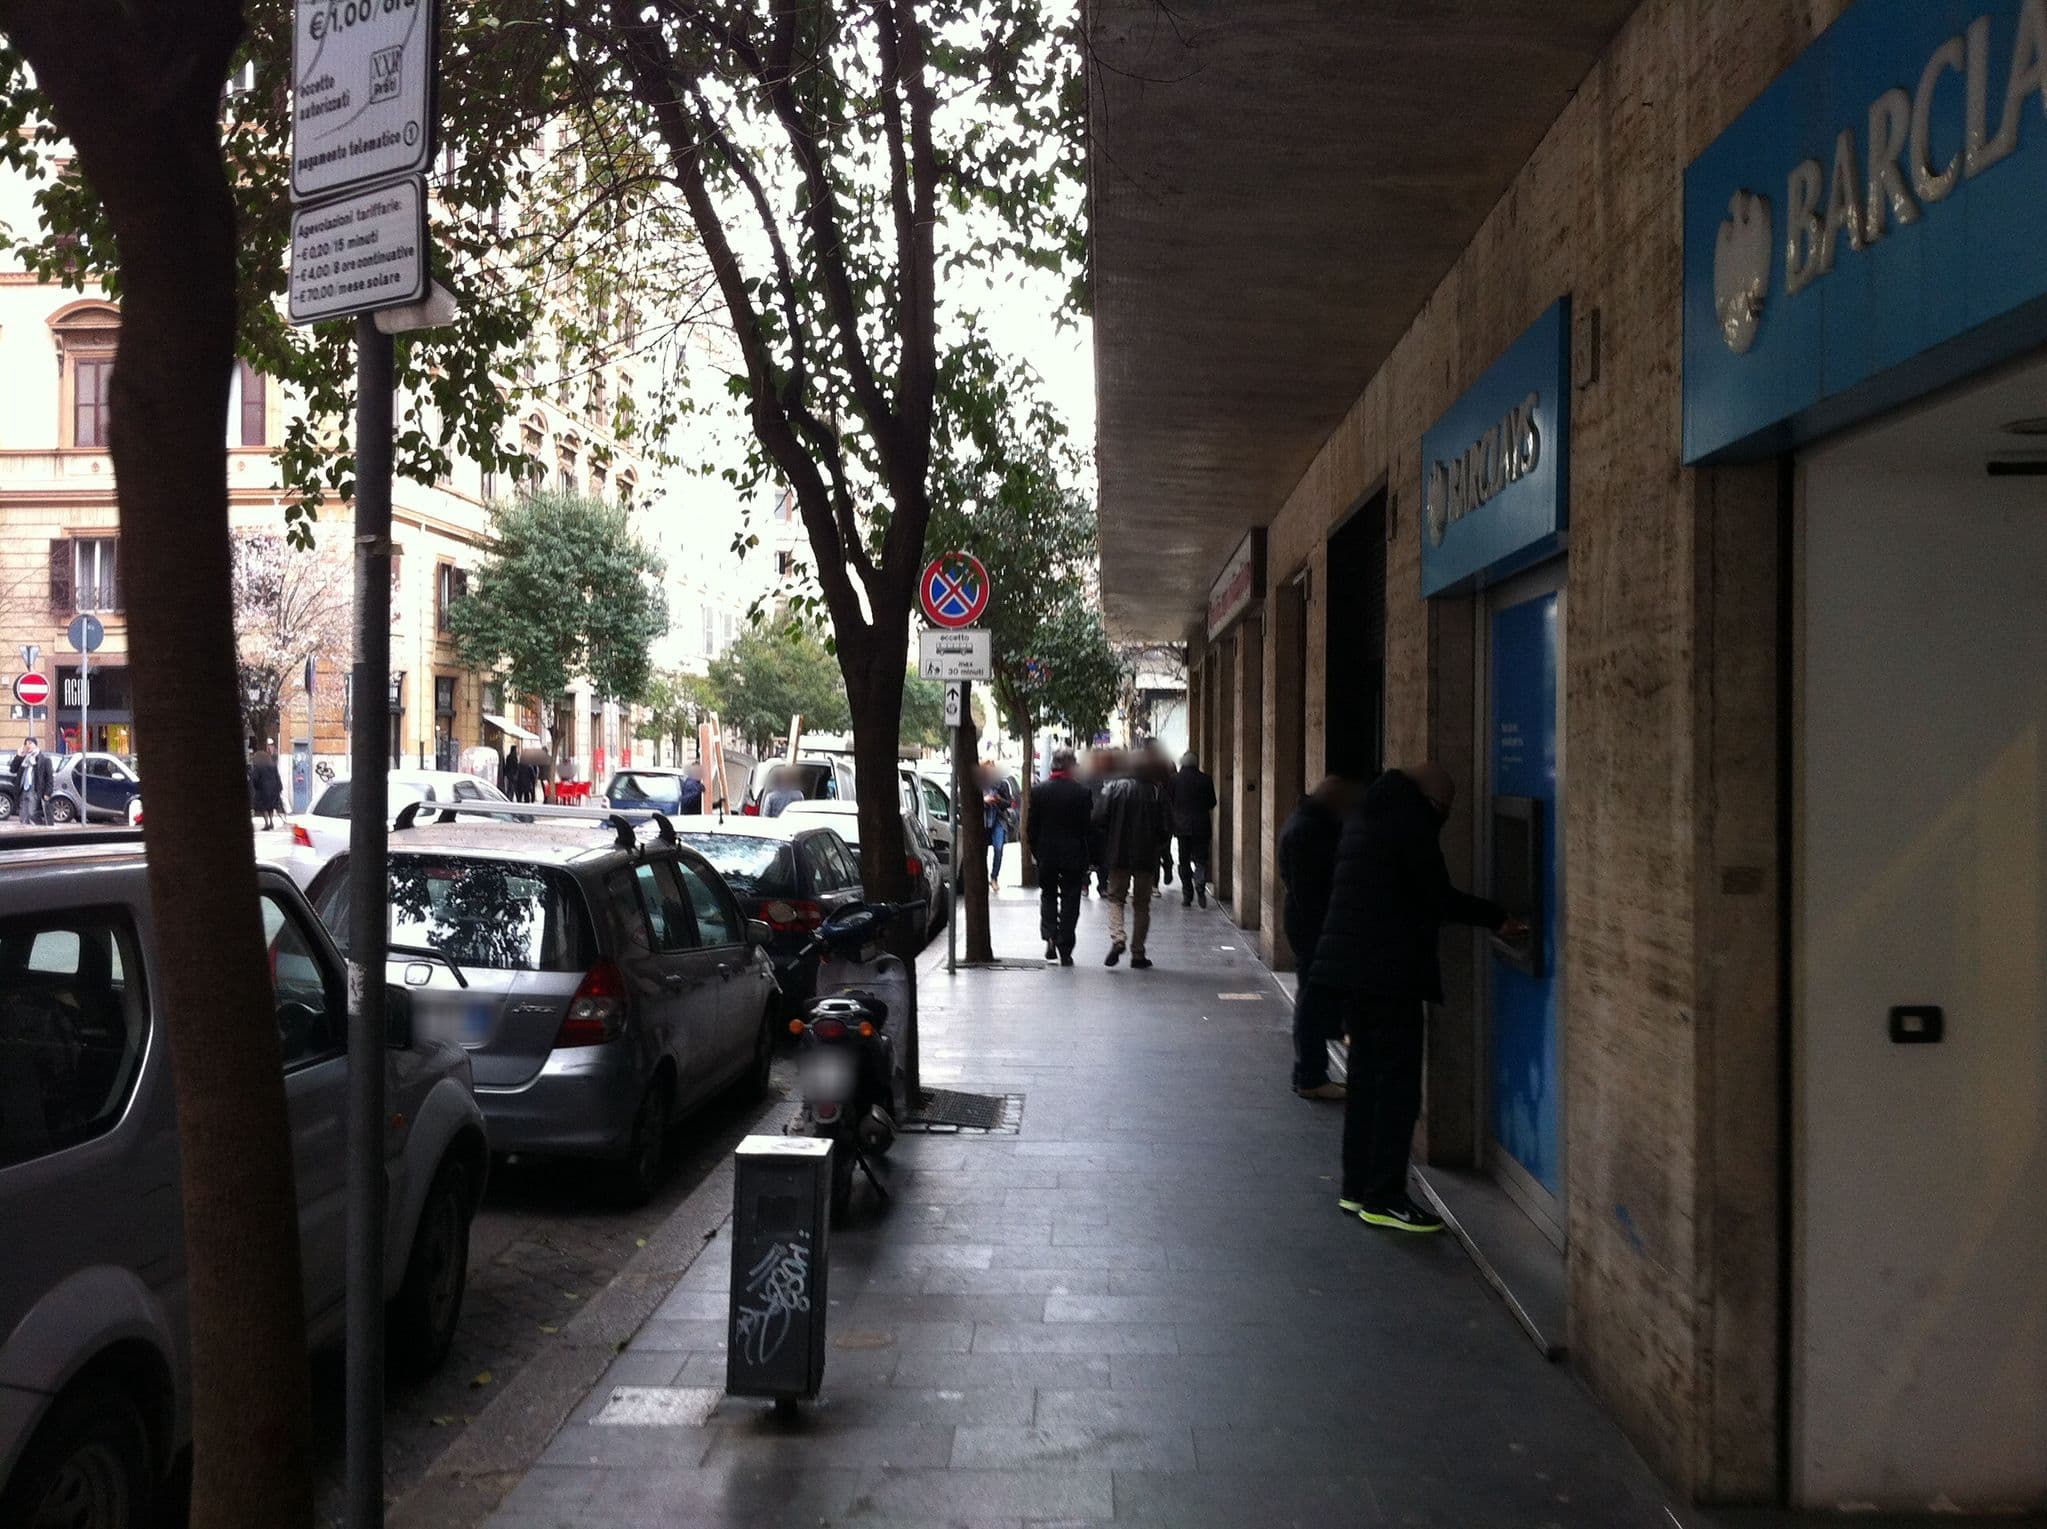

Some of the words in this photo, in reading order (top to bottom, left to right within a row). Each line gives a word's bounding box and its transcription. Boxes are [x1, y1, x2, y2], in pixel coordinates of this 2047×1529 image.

[298, 145, 346, 170] pagamento
[349, 131, 401, 156] telematico
[298, 210, 353, 239] Agevolazioni
[333, 238, 344, 252] 15
[347, 229, 379, 249] minuti
[342, 260, 355, 271] ore
[358, 245, 414, 268] continuative
[338, 279, 365, 294] mese
[368, 272, 400, 288] solare
[948, 668, 959, 676] 30
[960, 668, 984, 676] minuti
